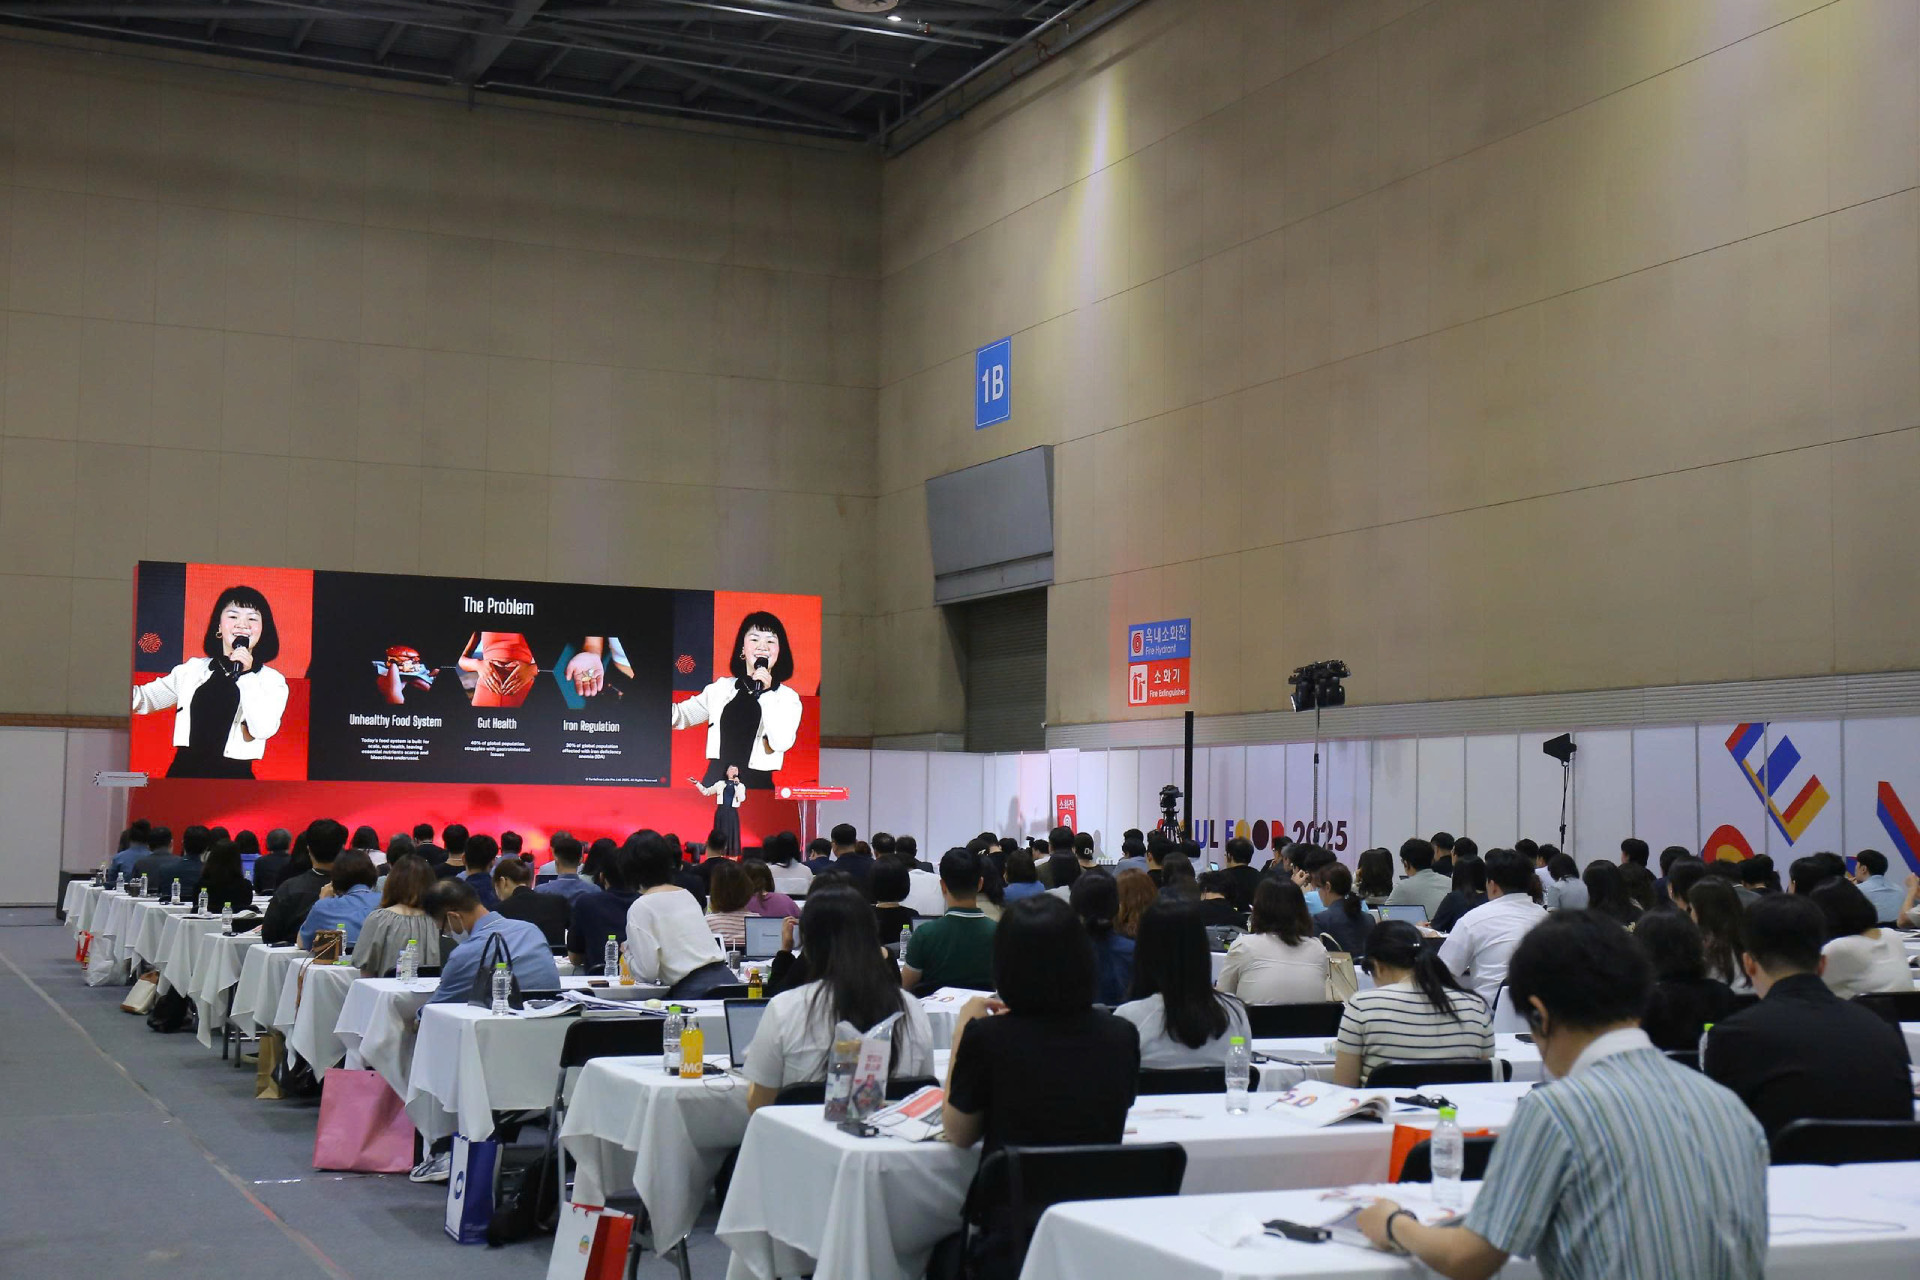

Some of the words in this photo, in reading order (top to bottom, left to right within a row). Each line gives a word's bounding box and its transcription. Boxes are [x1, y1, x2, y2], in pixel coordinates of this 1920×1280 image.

[981, 363, 1004, 404] 1B
[463, 596, 484, 613] The
[487, 597, 534, 616] Problem
[1145, 624, 1186, 644] 옥내소화전
[1145, 646, 1154, 656] Fire
[1155, 644, 1177, 656] Hydrant
[1149, 689, 1158, 698] Fire
[1158, 688, 1186, 698] Extinguisher
[349, 713, 390, 729] Unhealthy
[391, 714, 411, 727] Food
[412, 715, 442, 729] System
[477, 717, 491, 729] Gut
[492, 717, 517, 730] Health
[563, 719, 579, 731] Iron
[580, 720, 620, 733] Regulation
